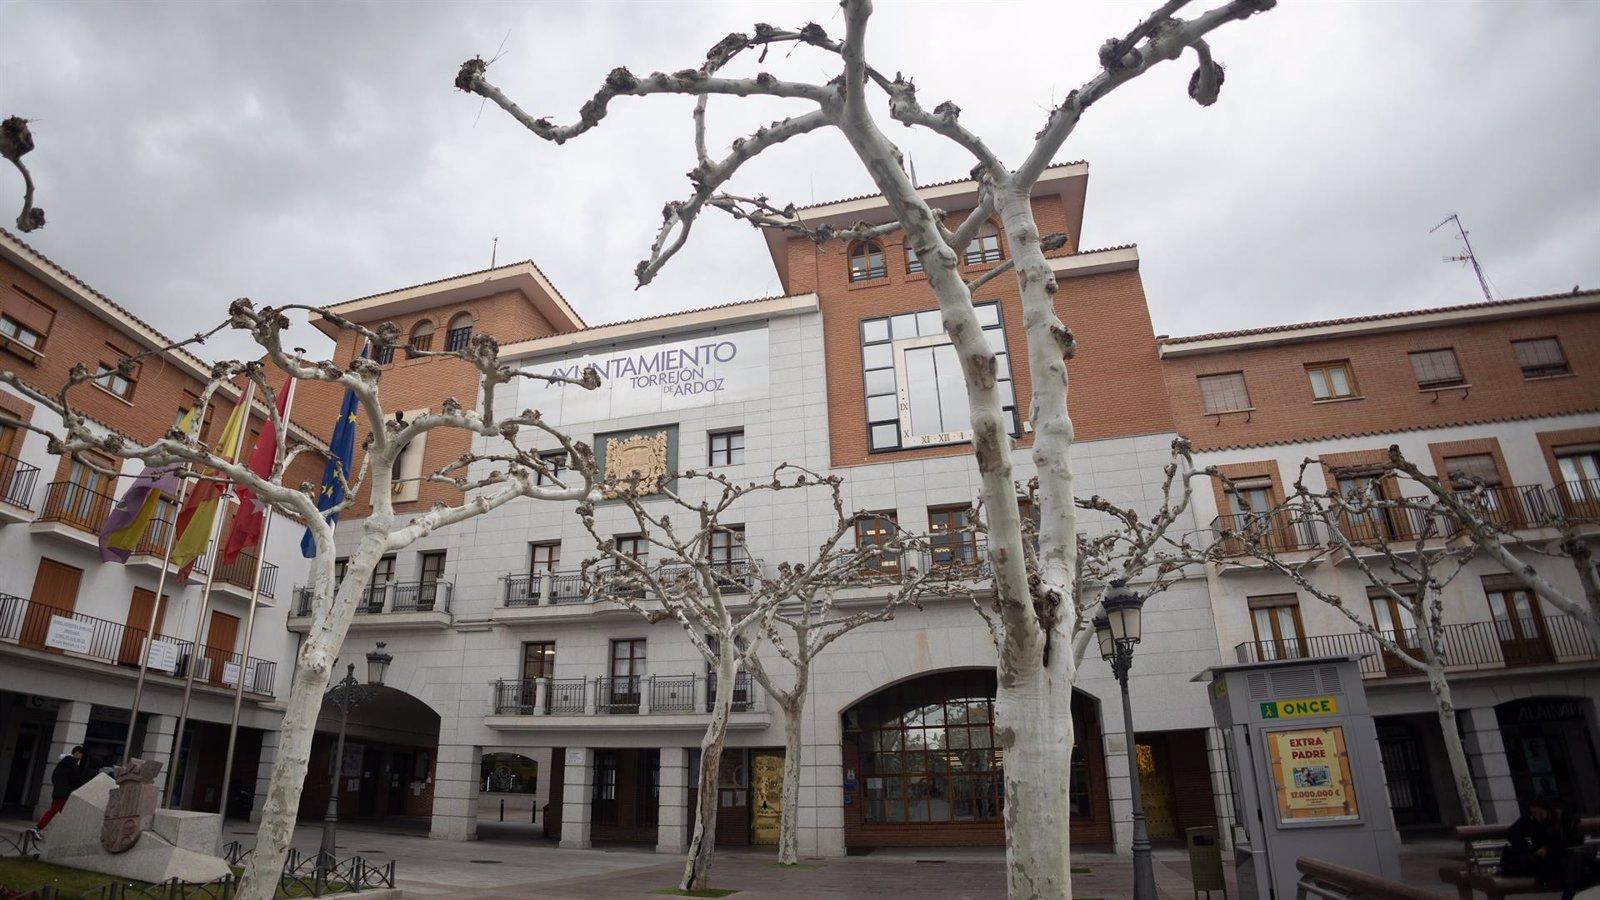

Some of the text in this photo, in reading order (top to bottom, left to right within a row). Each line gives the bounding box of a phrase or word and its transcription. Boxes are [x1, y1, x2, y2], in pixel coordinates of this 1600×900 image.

[630, 367, 704, 389] TORREJÓN
[674, 378, 724, 397] ARDOZ
[1284, 700, 1330, 714] ONCE
[1290, 737, 1323, 747] EXTRA
[1292, 750, 1326, 759] PADRE
[1291, 790, 1333, 798] 17.000.000
